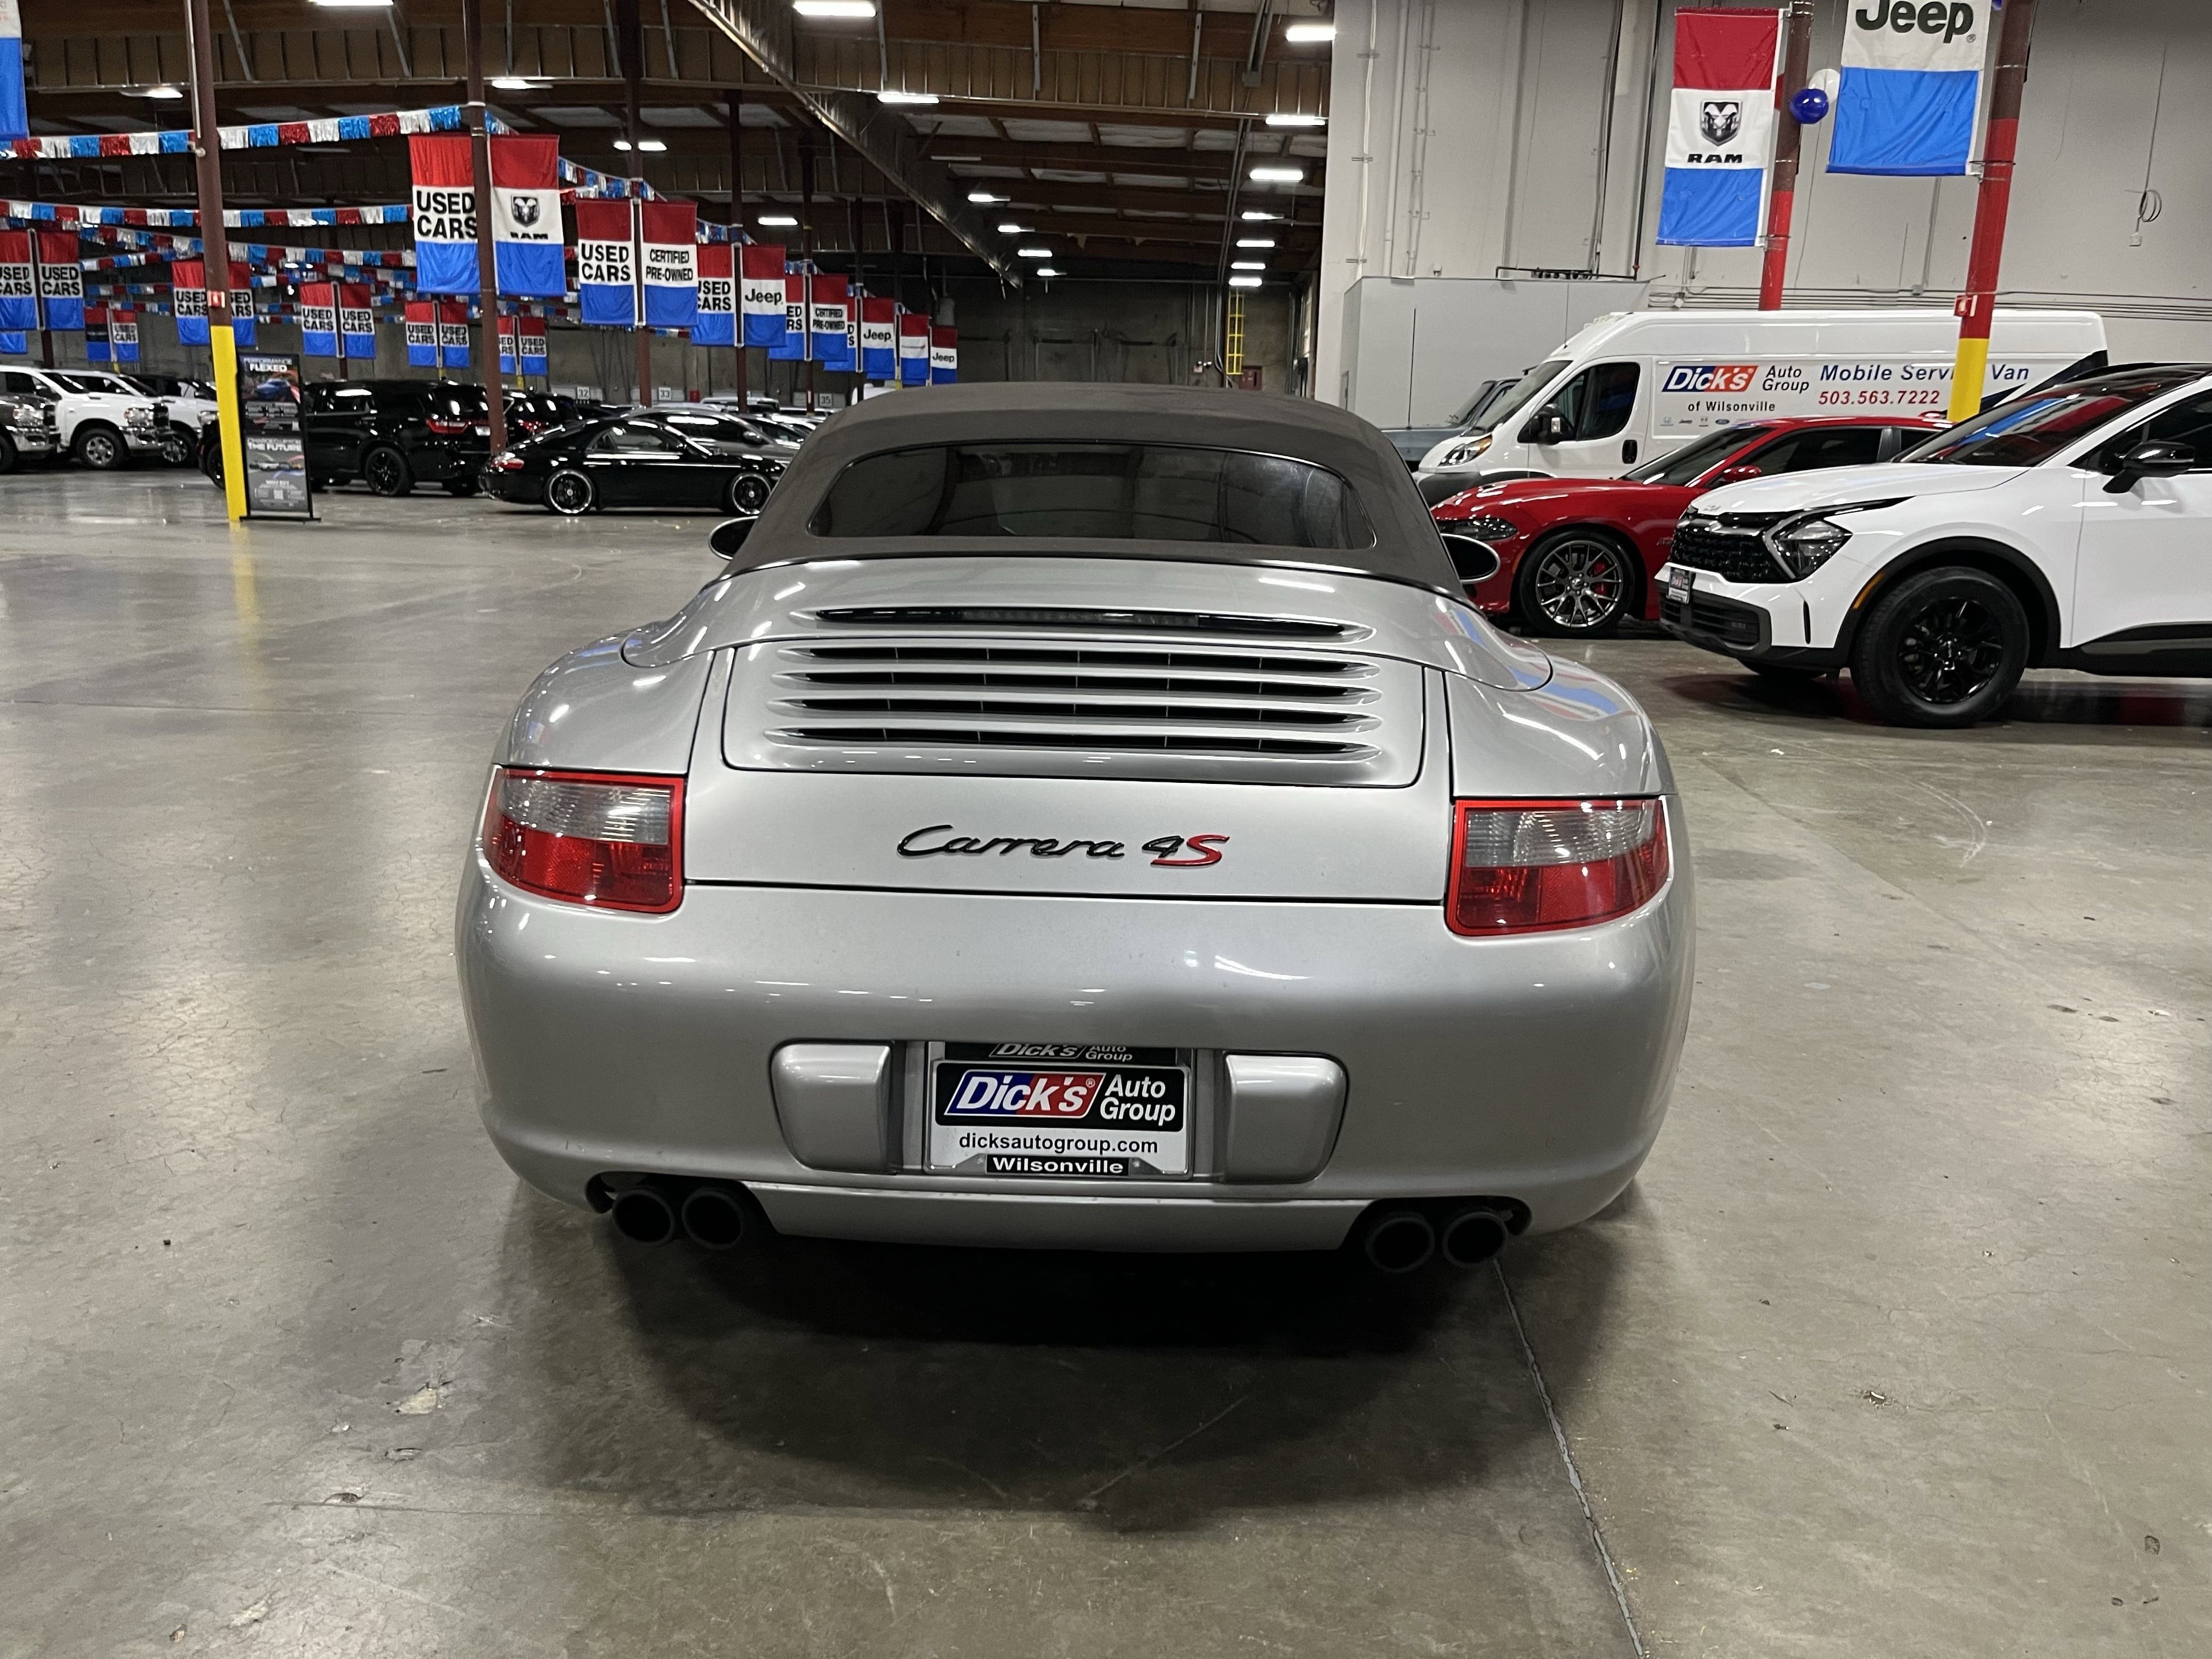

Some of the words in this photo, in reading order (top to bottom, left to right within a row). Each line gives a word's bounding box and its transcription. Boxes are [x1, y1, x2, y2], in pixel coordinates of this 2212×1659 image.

[1855, 0, 1974, 43] Jeep
[1687, 153, 1742, 163] RAM
[416, 191, 475, 214] USED
[417, 215, 478, 240] CARS
[581, 244, 629, 263] USED
[650, 249, 690, 264] CERTIFIED
[41, 267, 79, 280] USED
[582, 263, 631, 282] CARS
[646, 266, 693, 282] PRE-OWNED
[0, 282, 32, 295] ARS
[41, 282, 80, 295] CARS
[176, 291, 207, 303] USED
[745, 289, 782, 305] Jeep
[177, 304, 208, 316] CARS
[303, 308, 332, 320] USED
[343, 309, 370, 321] USED
[786, 305, 802, 317] ED
[816, 308, 843, 317] CERTIFIED
[303, 319, 334, 331] CARS
[343, 320, 373, 332] CARS
[408, 324, 434, 334] USED
[442, 325, 467, 335] USED
[786, 319, 802, 330] RS
[813, 319, 845, 330] PRE-OWNED
[408, 334, 435, 344] CARS
[442, 335, 467, 345] CARS
[863, 329, 892, 342] Jeep
[521, 338, 544, 346] USED
[502, 346, 513, 354] RS
[522, 346, 545, 355] CARS
[932, 352, 955, 363] Jeep
[249, 363, 287, 372] FLEXED
[1766, 365, 1802, 378] Auto
[1820, 365, 1892, 381] Mobile
[1901, 365, 1954, 381] Servi
[1992, 365, 2029, 380] Van
[1762, 378, 1809, 394] Group
[821, 396, 831, 404] 35
[1819, 391, 1940, 404] 503.563.7222
[1688, 402, 1700, 411] of
[1706, 402, 1775, 411] Wilsonville
[897, 824, 1125, 858] Carrera
[1142, 835, 1230, 866] 4S
[1085, 1051, 1132, 1062] Group
[1105, 1074, 1166, 1099] Auto
[956, 1074, 1088, 1113] Dick's
[1100, 1097, 1176, 1127] Group
[959, 1133, 1158, 1154] dicksautogroup.com
[993, 1157, 1124, 1174] Wilsonville
